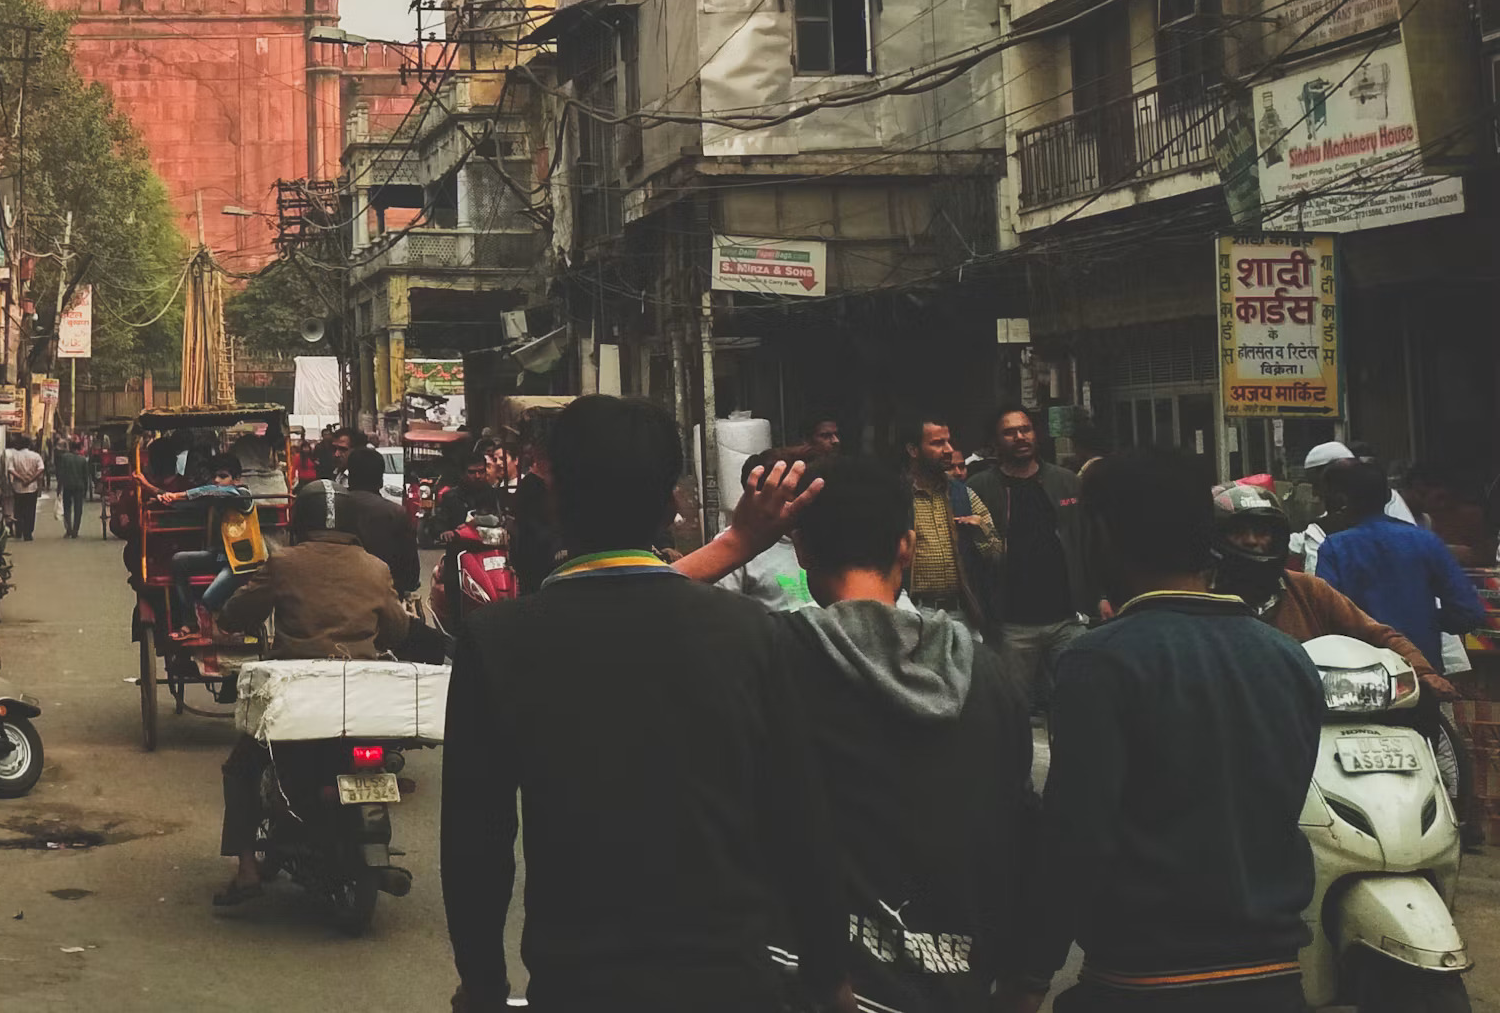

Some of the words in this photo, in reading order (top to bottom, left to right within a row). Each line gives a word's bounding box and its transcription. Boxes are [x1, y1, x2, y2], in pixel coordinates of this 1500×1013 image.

[1288, 143, 1322, 169] Sindhu
[1323, 131, 1378, 162] Machinery
[1379, 123, 1414, 149] House
[721, 262, 734, 273] S.
[773, 266, 782, 276] &
[1236, 250, 1316, 288] शादी
[1267, 327, 1279, 341] के
[1230, 385, 1273, 401] अजय
[1353, 753, 1418, 770] AS9273
